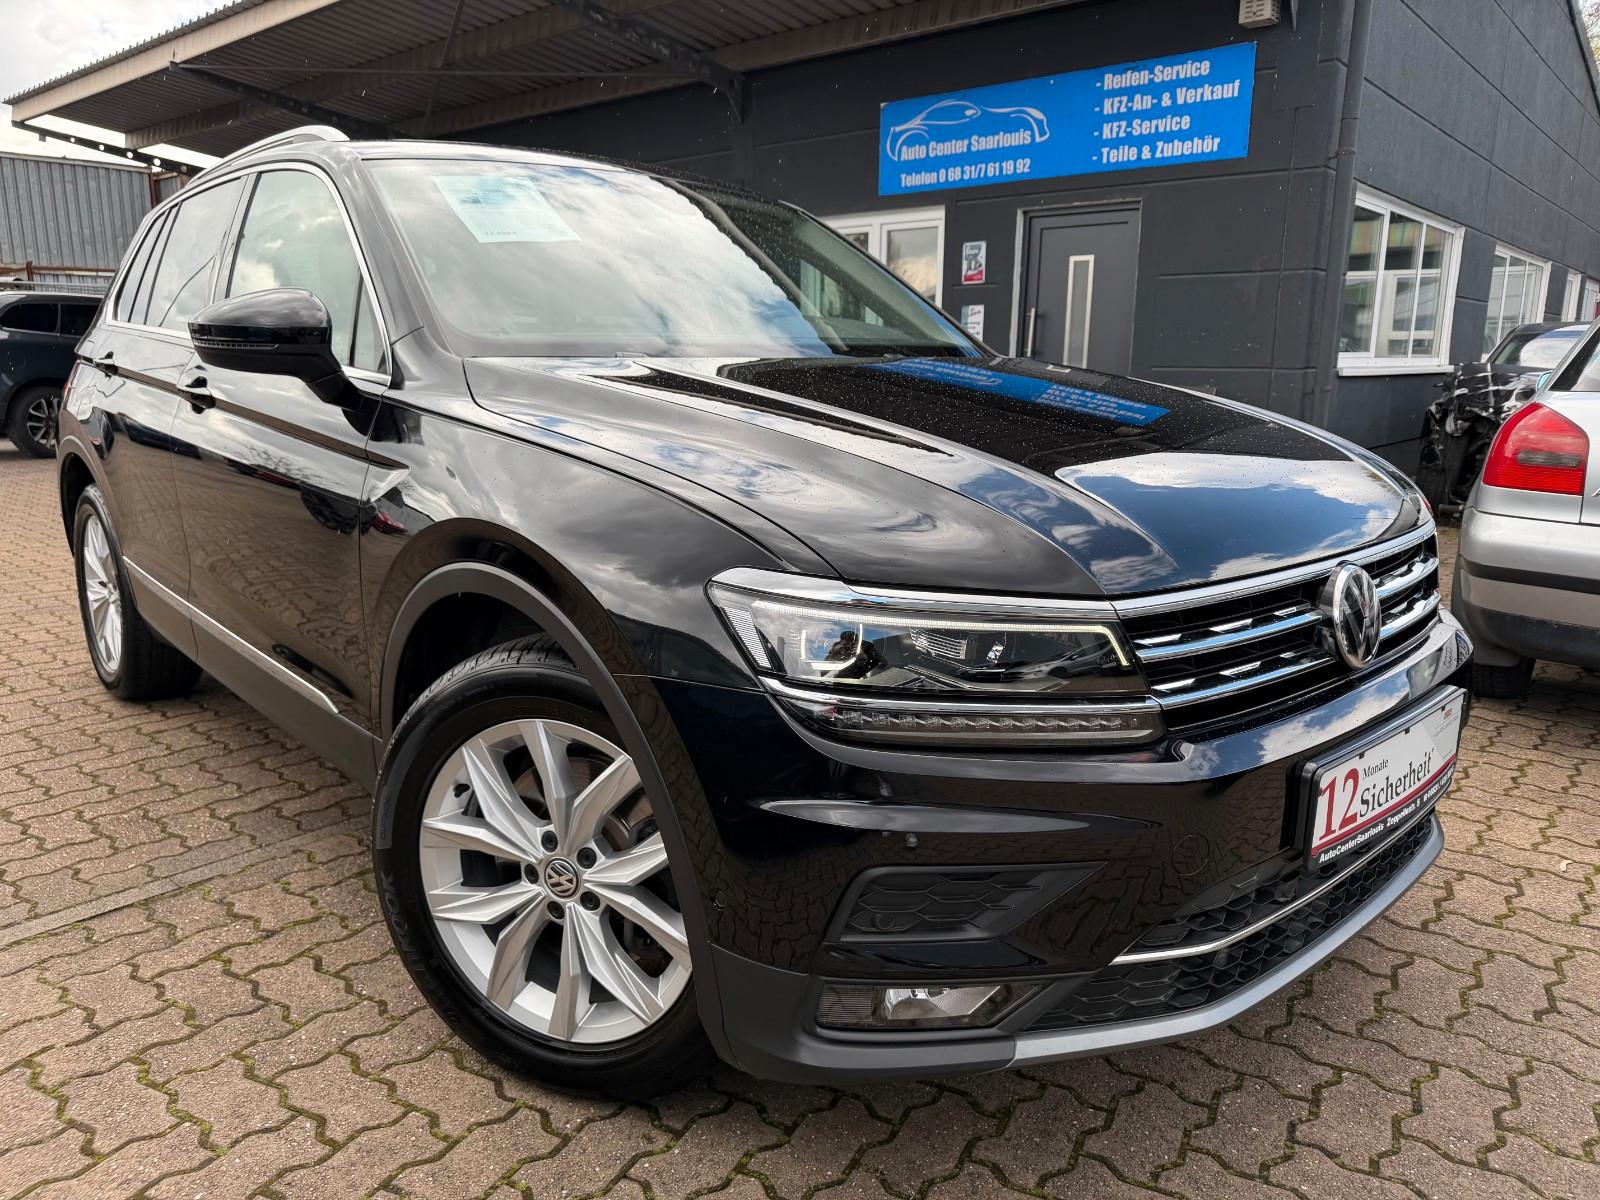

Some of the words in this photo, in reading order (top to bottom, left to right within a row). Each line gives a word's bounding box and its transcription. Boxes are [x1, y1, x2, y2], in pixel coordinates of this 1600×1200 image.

[1104, 60, 1210, 91] Reifen-Service
[1103, 94, 1158, 115] KFZ-An-
[1161, 92, 1172, 107] &
[1176, 79, 1241, 105] Verkauf
[1102, 114, 1191, 140] KFZ-Service
[900, 145, 927, 161] Auto
[928, 139, 969, 157] Center
[970, 129, 1032, 152] Saarlouis
[1101, 145, 1137, 164] Teile
[1141, 145, 1152, 159] &
[1155, 135, 1221, 158] Zubehör
[900, 171, 938, 188] Telefon
[947, 166, 961, 182] 68
[963, 163, 985, 180] 31/7
[987, 161, 999, 177] 61
[1001, 160, 1014, 175] 19
[1016, 158, 1031, 173] 92
[1363, 759, 1389, 780] Monate
[1319, 768, 1360, 841] 12
